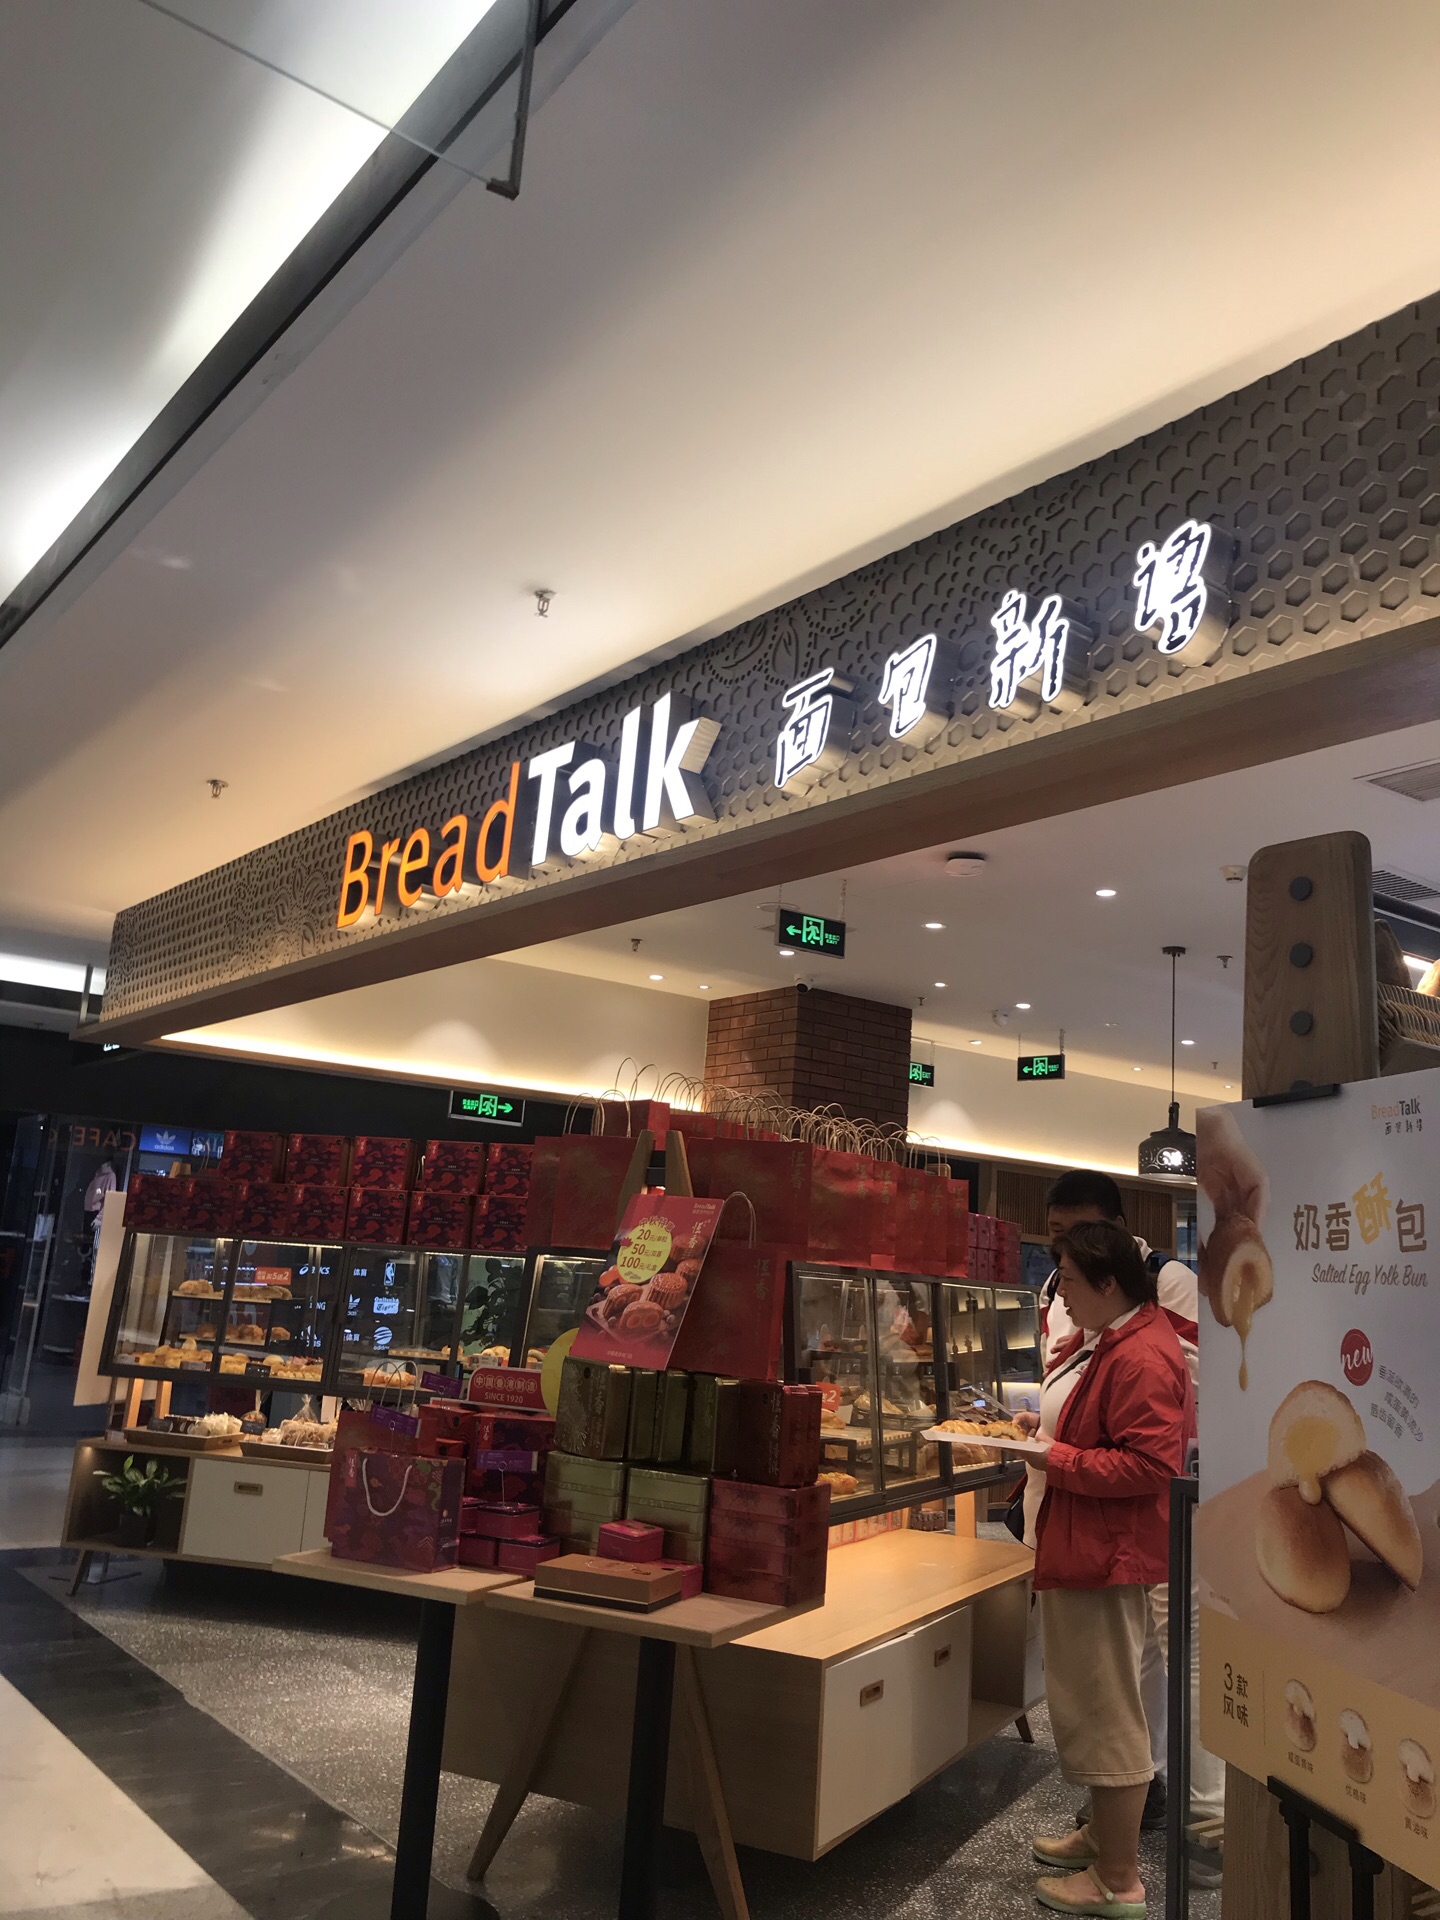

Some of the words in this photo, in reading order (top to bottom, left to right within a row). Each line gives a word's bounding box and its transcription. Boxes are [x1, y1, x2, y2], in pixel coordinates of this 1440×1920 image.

[773, 519, 1214, 790] 面包新语
[336, 691, 704, 931] BreadTalk
[1371, 1098, 1421, 1119] BreadTalk
[1292, 1171, 1428, 1253] 奶香酥包
[1311, 1262, 1347, 1285] Salted
[1349, 1265, 1371, 1295] Egg
[1373, 1264, 1400, 1287] Yolk
[1402, 1263, 1428, 1288] Bun
[1340, 1345, 1374, 1372] new
[484, 1391, 505, 1401] SINCE
[506, 1394, 524, 1404] 1920
[1223, 1694, 1249, 1728] 风味
